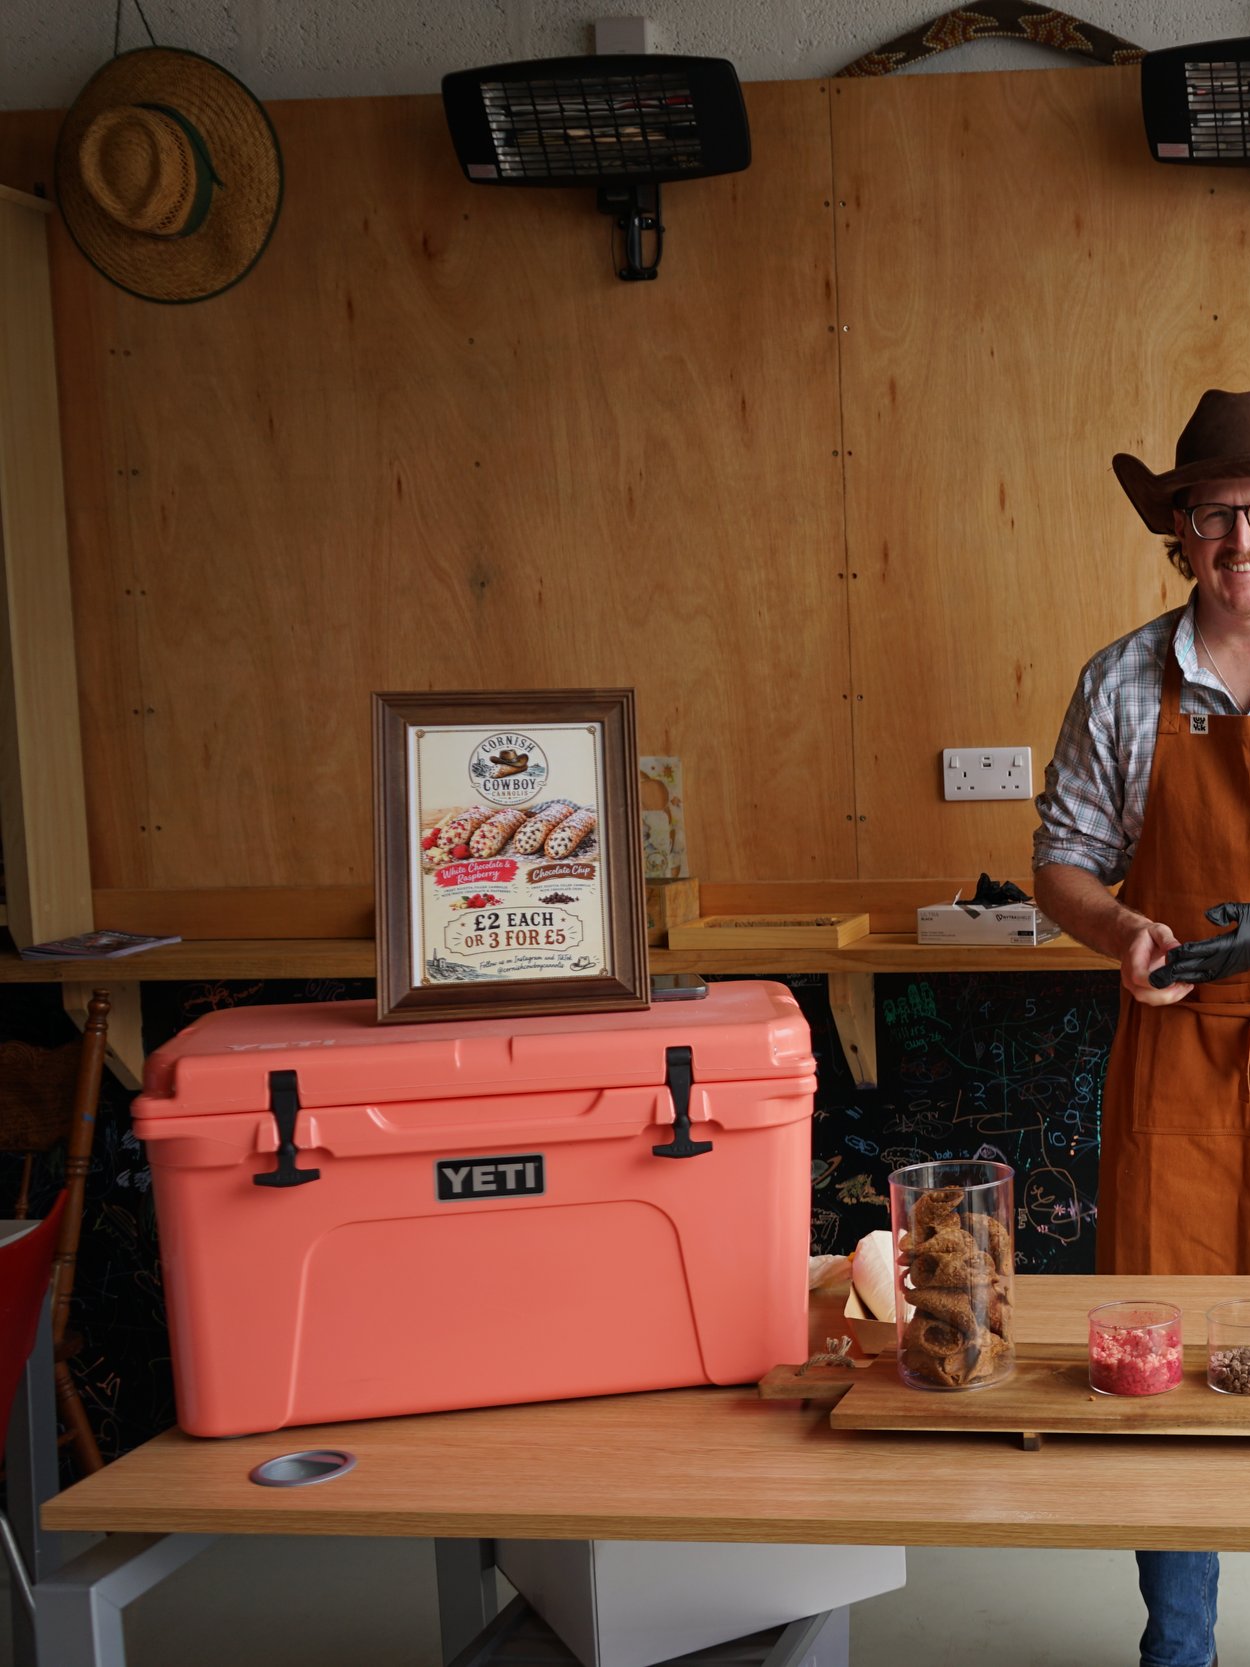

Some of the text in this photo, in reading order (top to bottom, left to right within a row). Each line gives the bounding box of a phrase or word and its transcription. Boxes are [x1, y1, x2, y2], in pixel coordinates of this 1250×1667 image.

[481, 735, 536, 754] CORNISH
[483, 778, 537, 792] COWBOY
[441, 866, 467, 880] White
[468, 860, 504, 873] Chocolate
[457, 870, 500, 885] Raspberry
[532, 864, 591, 881] Chocolate Chip
[474, 911, 554, 932] £2 EACH
[464, 928, 566, 949] OR 3 FOR £5
[479, 961, 497, 970] Follow
[514, 955, 542, 964] Instagram
[441, 1162, 536, 1194] YETI
